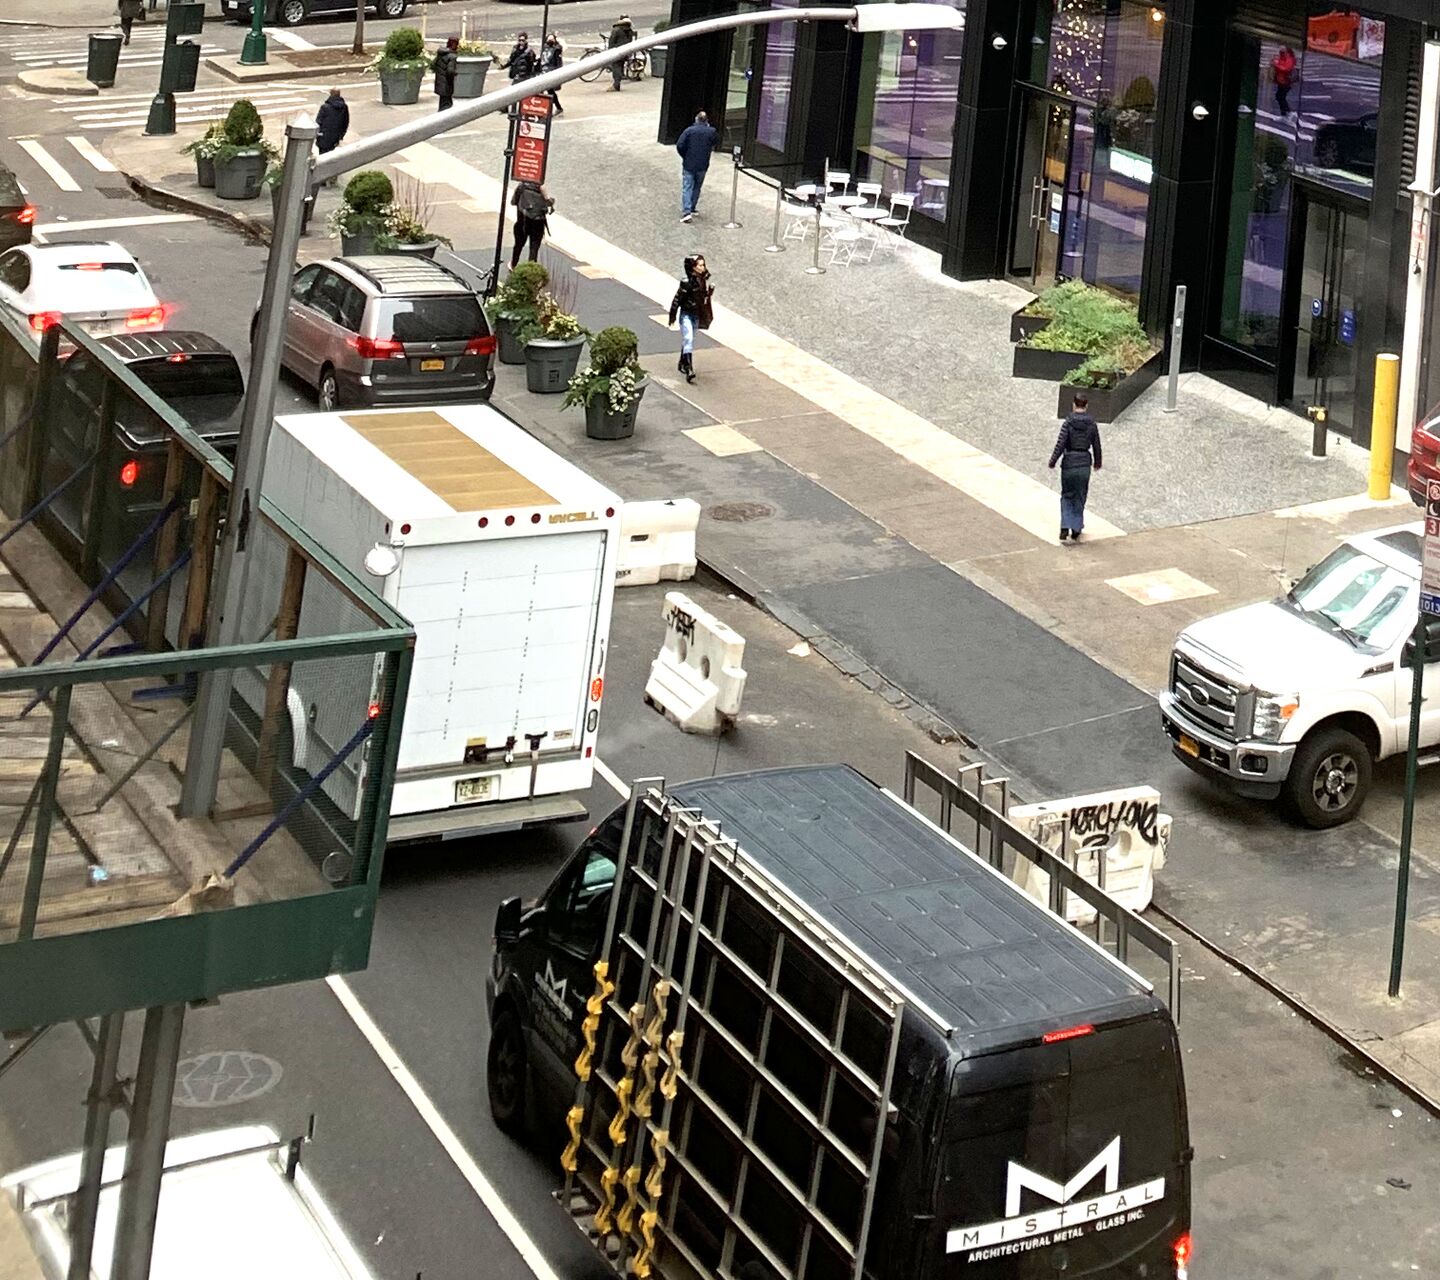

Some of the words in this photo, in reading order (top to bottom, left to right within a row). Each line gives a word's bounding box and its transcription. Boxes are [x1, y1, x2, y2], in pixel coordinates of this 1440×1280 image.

[1428, 520, 1437, 535] 3
[962, 1187, 1154, 1248] MISTRAL
[967, 1234, 1051, 1264] ARCHITECTURAL
[1053, 1227, 1084, 1244] METAL
[1095, 1216, 1126, 1233] GLASS
